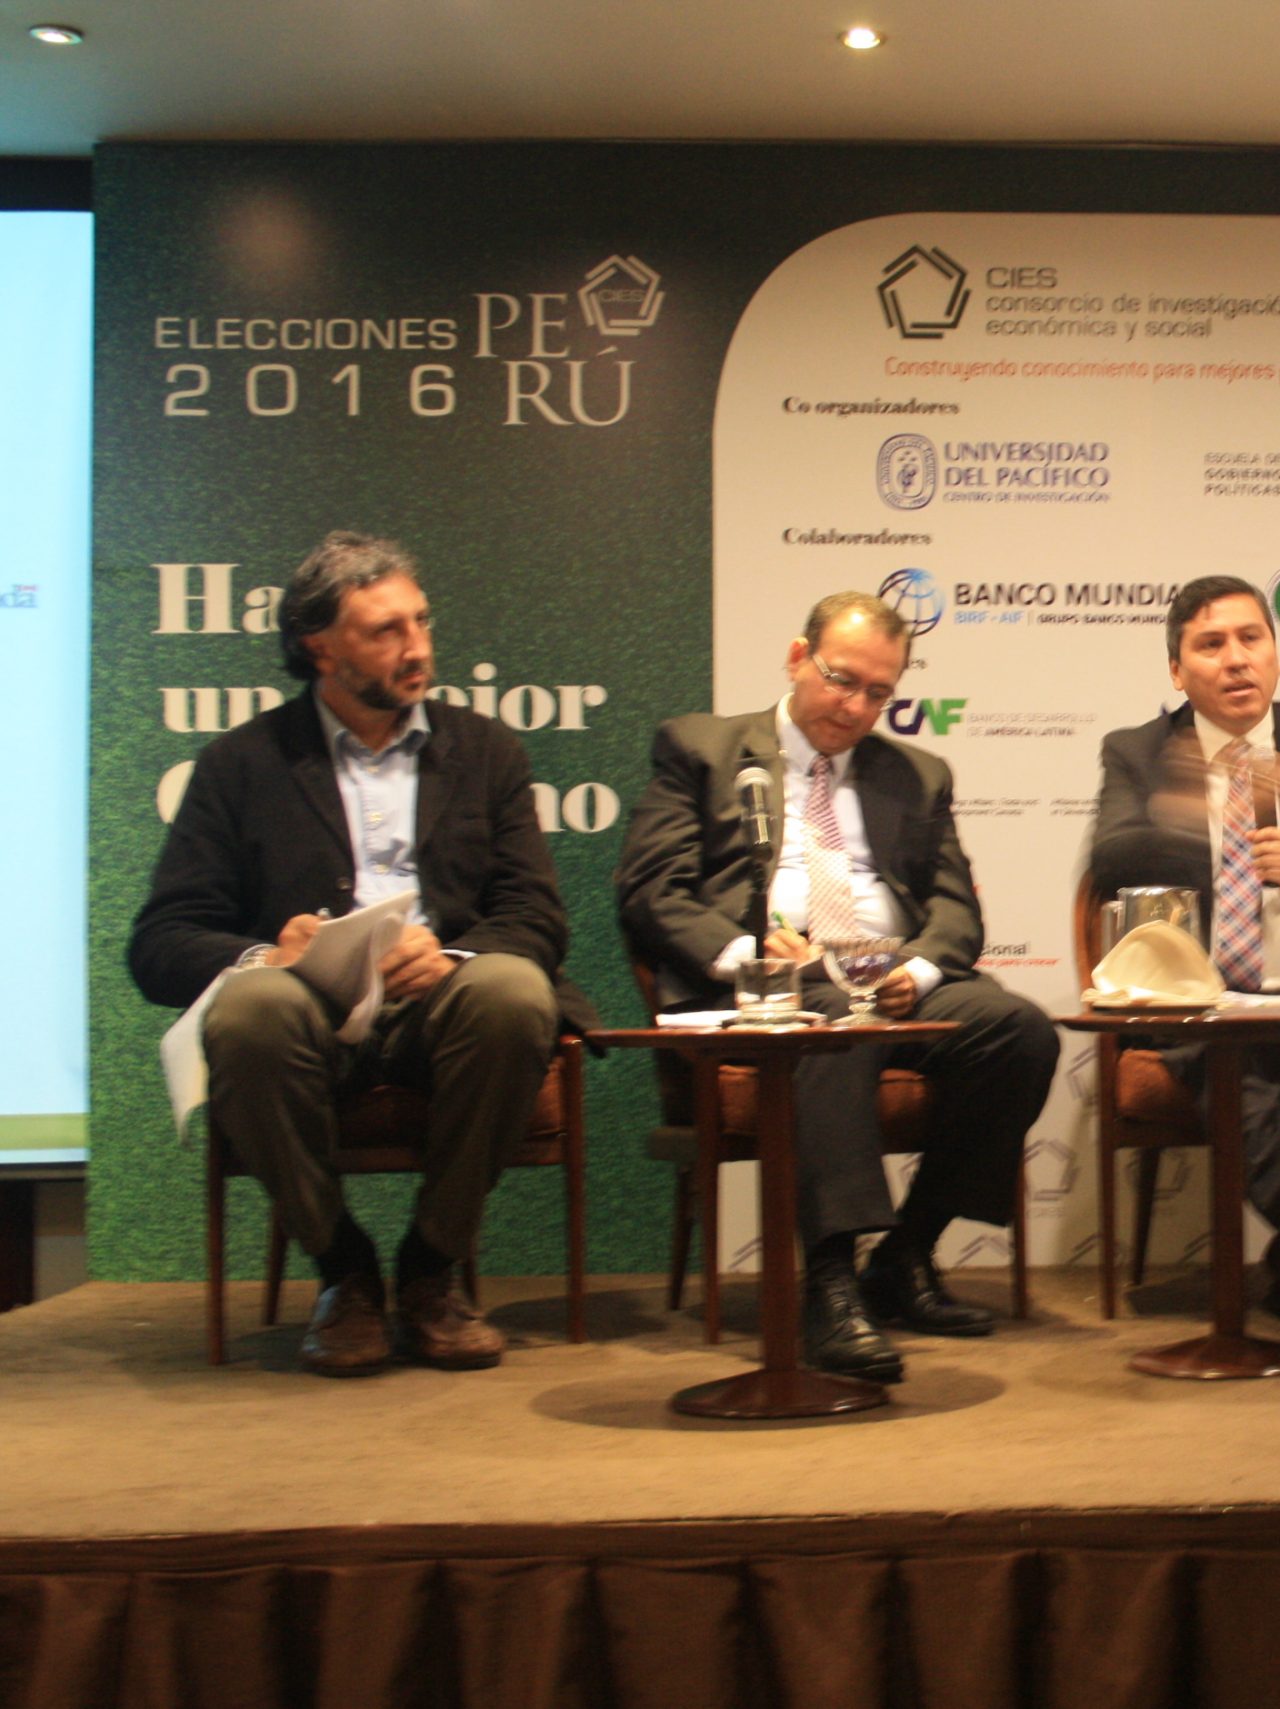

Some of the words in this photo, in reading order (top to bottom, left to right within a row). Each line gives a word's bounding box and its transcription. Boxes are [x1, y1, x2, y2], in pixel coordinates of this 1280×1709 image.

[985, 266, 1058, 290] CIES
[985, 294, 1104, 314] consorcio
[1112, 294, 1142, 314] de
[154, 316, 459, 350] ELECCIONES
[471, 293, 570, 358] PE
[985, 316, 1118, 337] económica
[1124, 319, 1138, 342] y
[1144, 317, 1213, 339] social
[884, 356, 1018, 381] Construyendo
[1021, 358, 1148, 379] conocimiento
[1152, 361, 1196, 384] para
[1200, 360, 1276, 384] mejores
[163, 363, 457, 416] 2016
[502, 346, 637, 426] RÚ
[783, 396, 811, 415] Co
[814, 397, 960, 418] organizadores
[943, 442, 1110, 462] UNIVERSIDAD
[943, 466, 989, 487] DEL
[996, 463, 1110, 487] PACÍFICO
[782, 527, 933, 545] Colaboradores
[954, 583, 1057, 606] BANCO
[1065, 582, 1185, 606] MUNDIA
[887, 698, 968, 736] CAF
